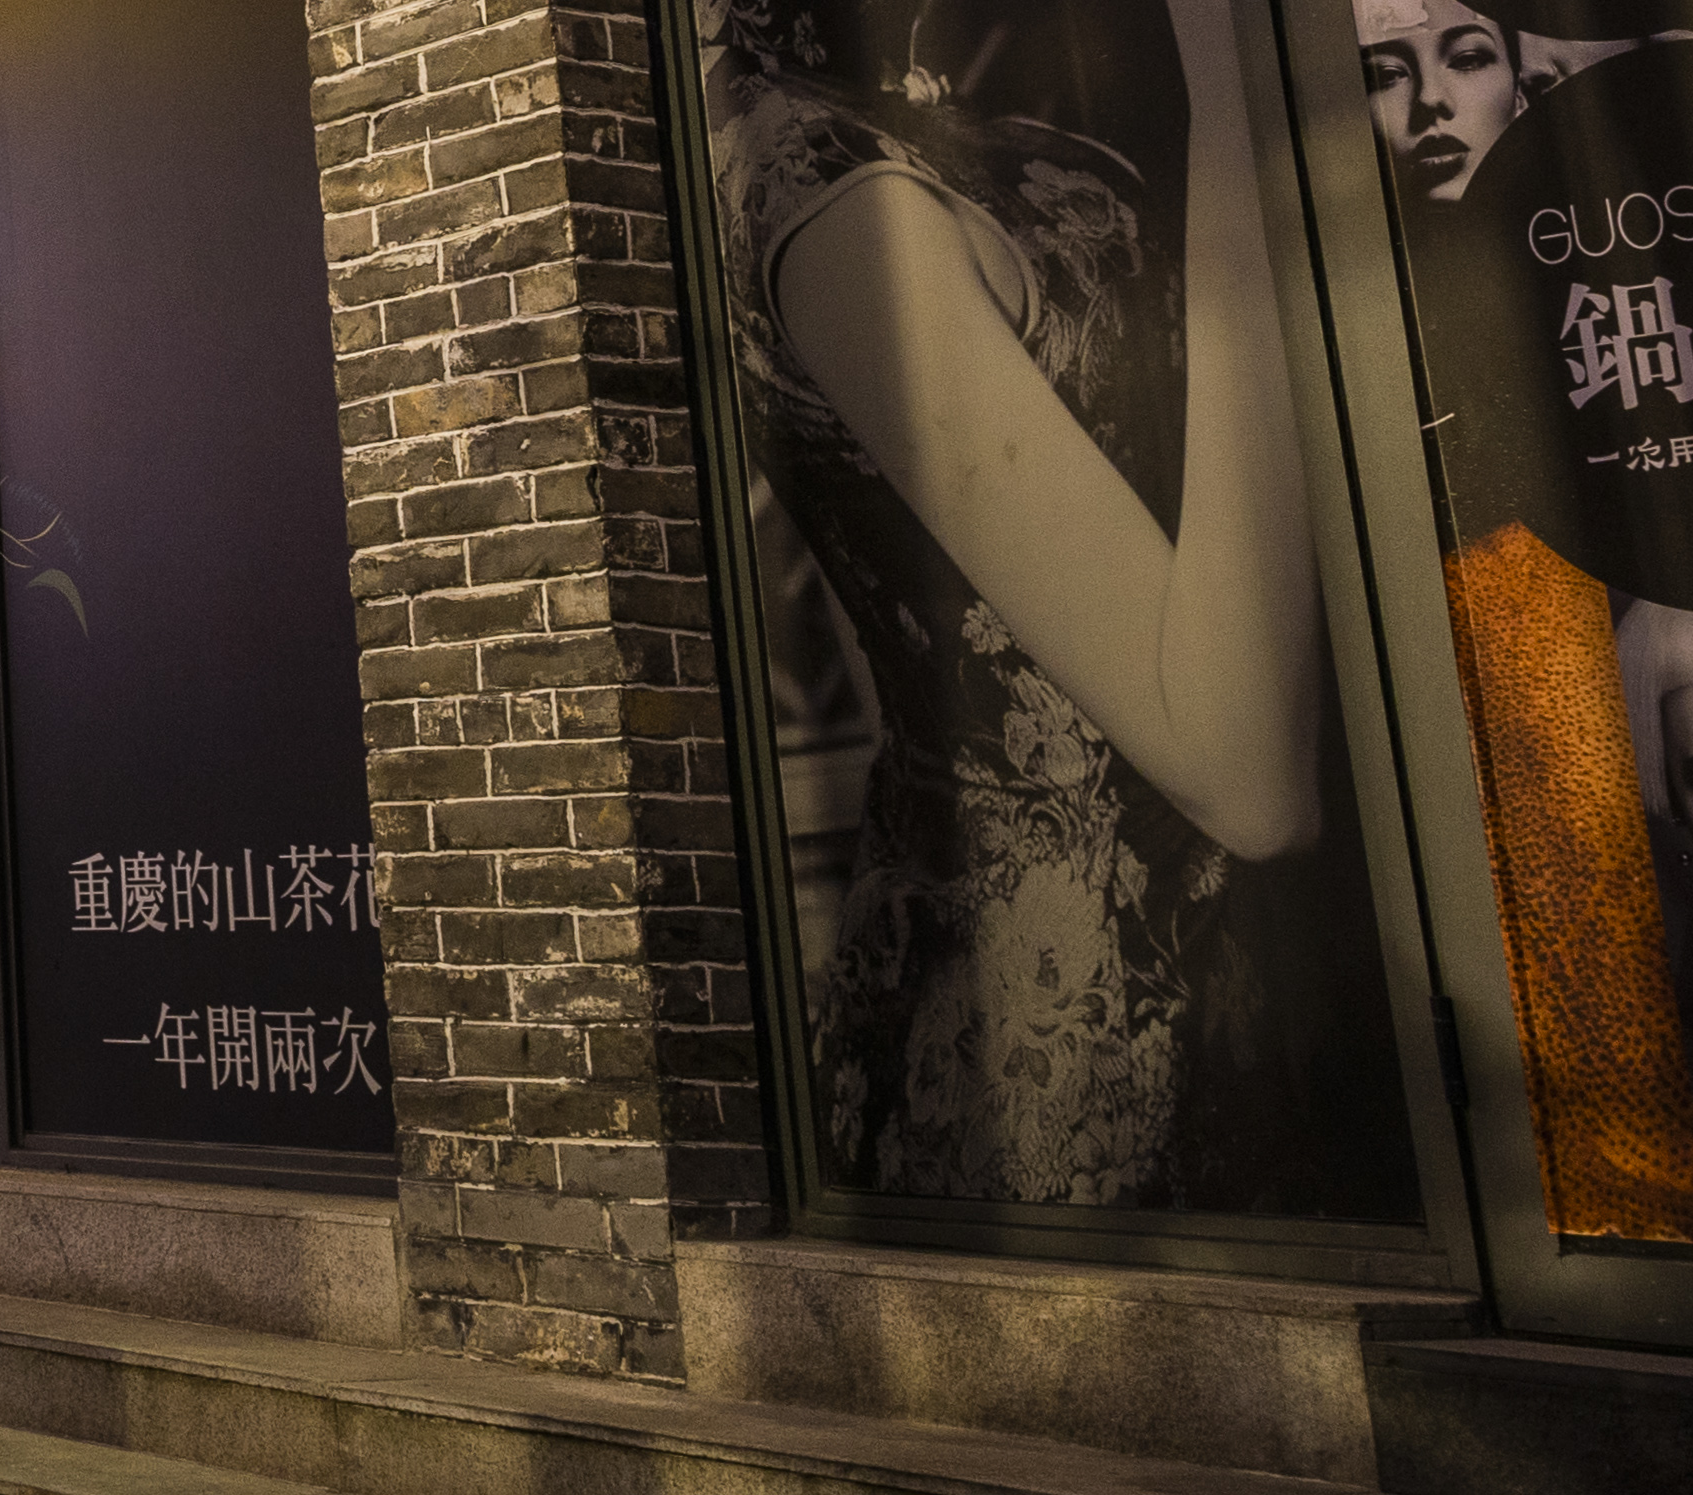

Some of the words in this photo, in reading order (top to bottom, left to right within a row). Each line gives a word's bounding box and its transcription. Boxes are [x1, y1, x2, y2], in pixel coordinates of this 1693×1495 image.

[1560, 275, 1693, 410] 鍋
[102, 1002, 382, 1096] 一年開兩次
